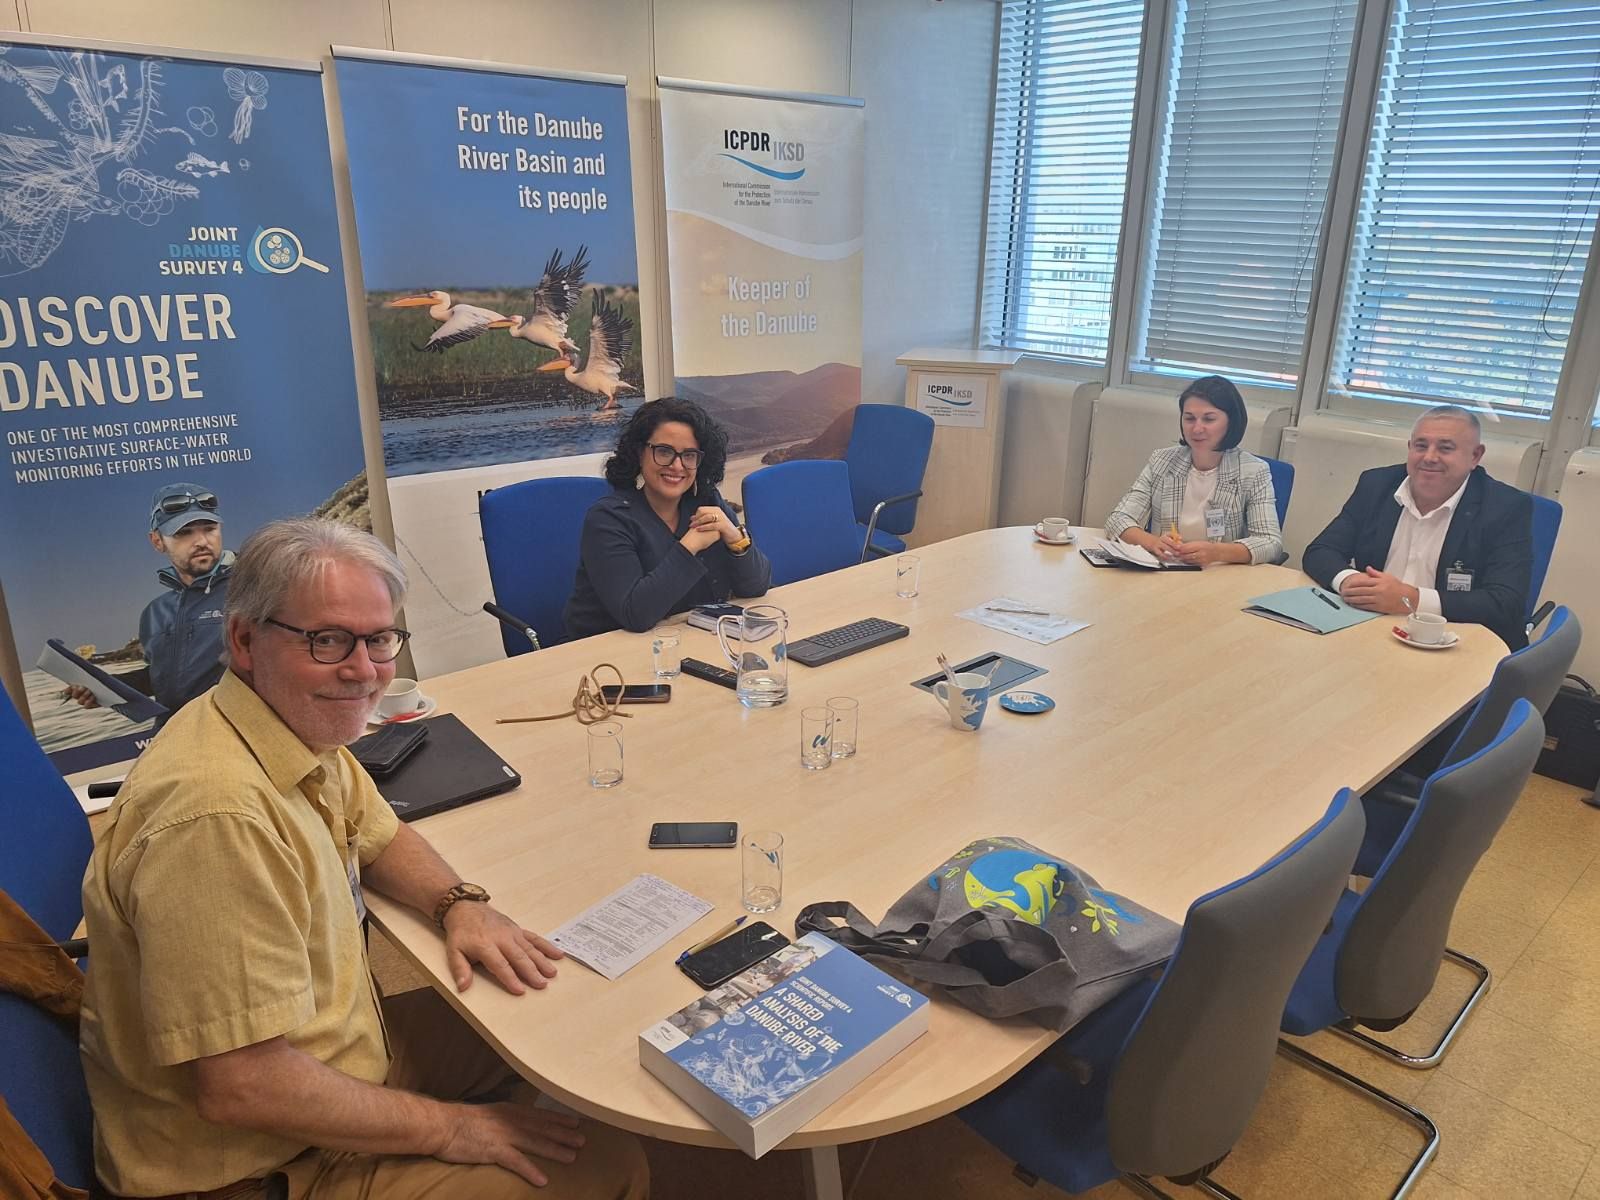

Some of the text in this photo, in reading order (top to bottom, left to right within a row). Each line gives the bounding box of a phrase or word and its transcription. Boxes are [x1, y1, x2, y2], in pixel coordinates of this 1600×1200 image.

[457, 106, 604, 141] For the Danube
[457, 144, 606, 176] River Basin and
[724, 129, 805, 161] ICPDR IKSD
[518, 184, 608, 214] its people
[188, 226, 238, 241] JOINT
[168, 243, 242, 258] DANUBE
[159, 260, 244, 276] SURVEY 4
[728, 274, 812, 305] Keeper of
[721, 310, 817, 337] the Danube
[0, 352, 204, 412] DANUBE
[927, 384, 953, 395] ICPDR
[7, 413, 239, 446] ONE OF THE MOST COMPREHENSIVE
[11, 432, 230, 465] INVESTIGATIVE SURFACE-WATER
[15, 448, 252, 484] MONITORING EFFORTS IN THE WORLD
[773, 987, 825, 1022] A SHARED
[745, 1005, 817, 1056] DANUBE RIVER
[760, 996, 844, 1055] ANALYSIS OF THE
